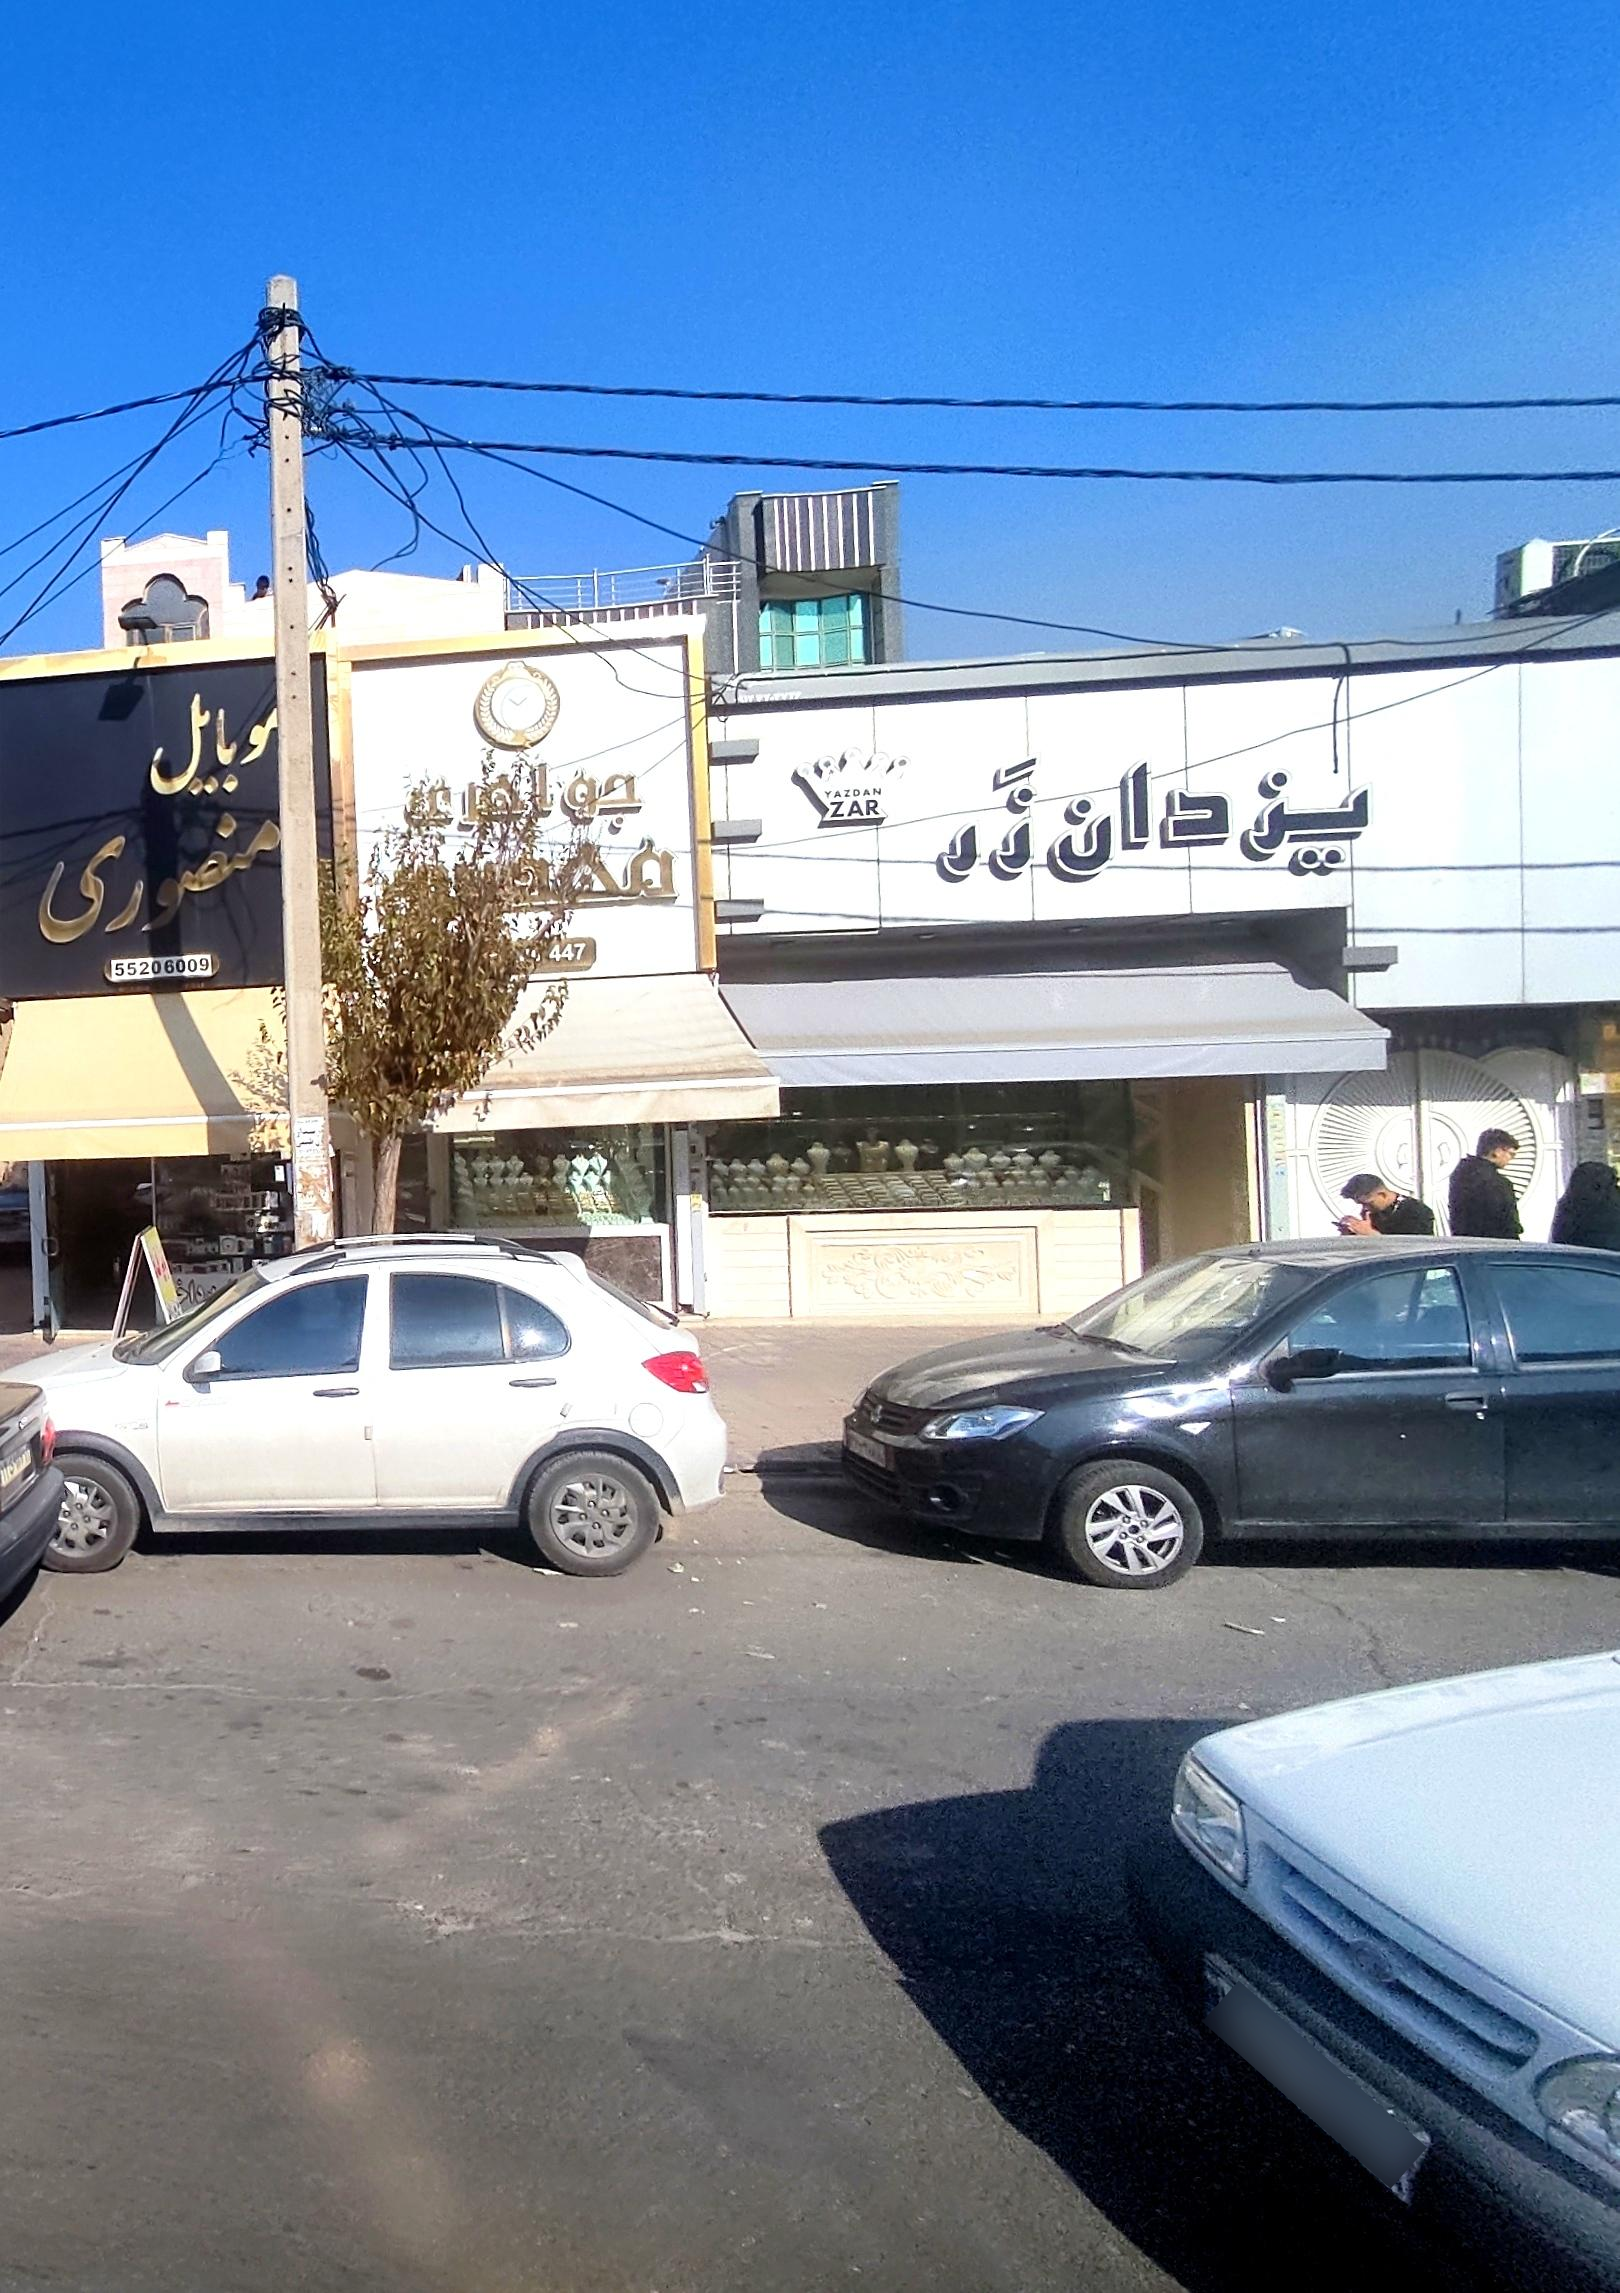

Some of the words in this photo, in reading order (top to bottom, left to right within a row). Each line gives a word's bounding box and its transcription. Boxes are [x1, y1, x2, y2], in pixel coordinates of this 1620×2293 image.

[824, 788, 882, 799] YAZDAN
[830, 800, 880, 818] ZAR
[1047, 758, 1371, 878] یزدان
[38, 812, 280, 944] منصوری
[114, 958, 210, 977] 55206009
